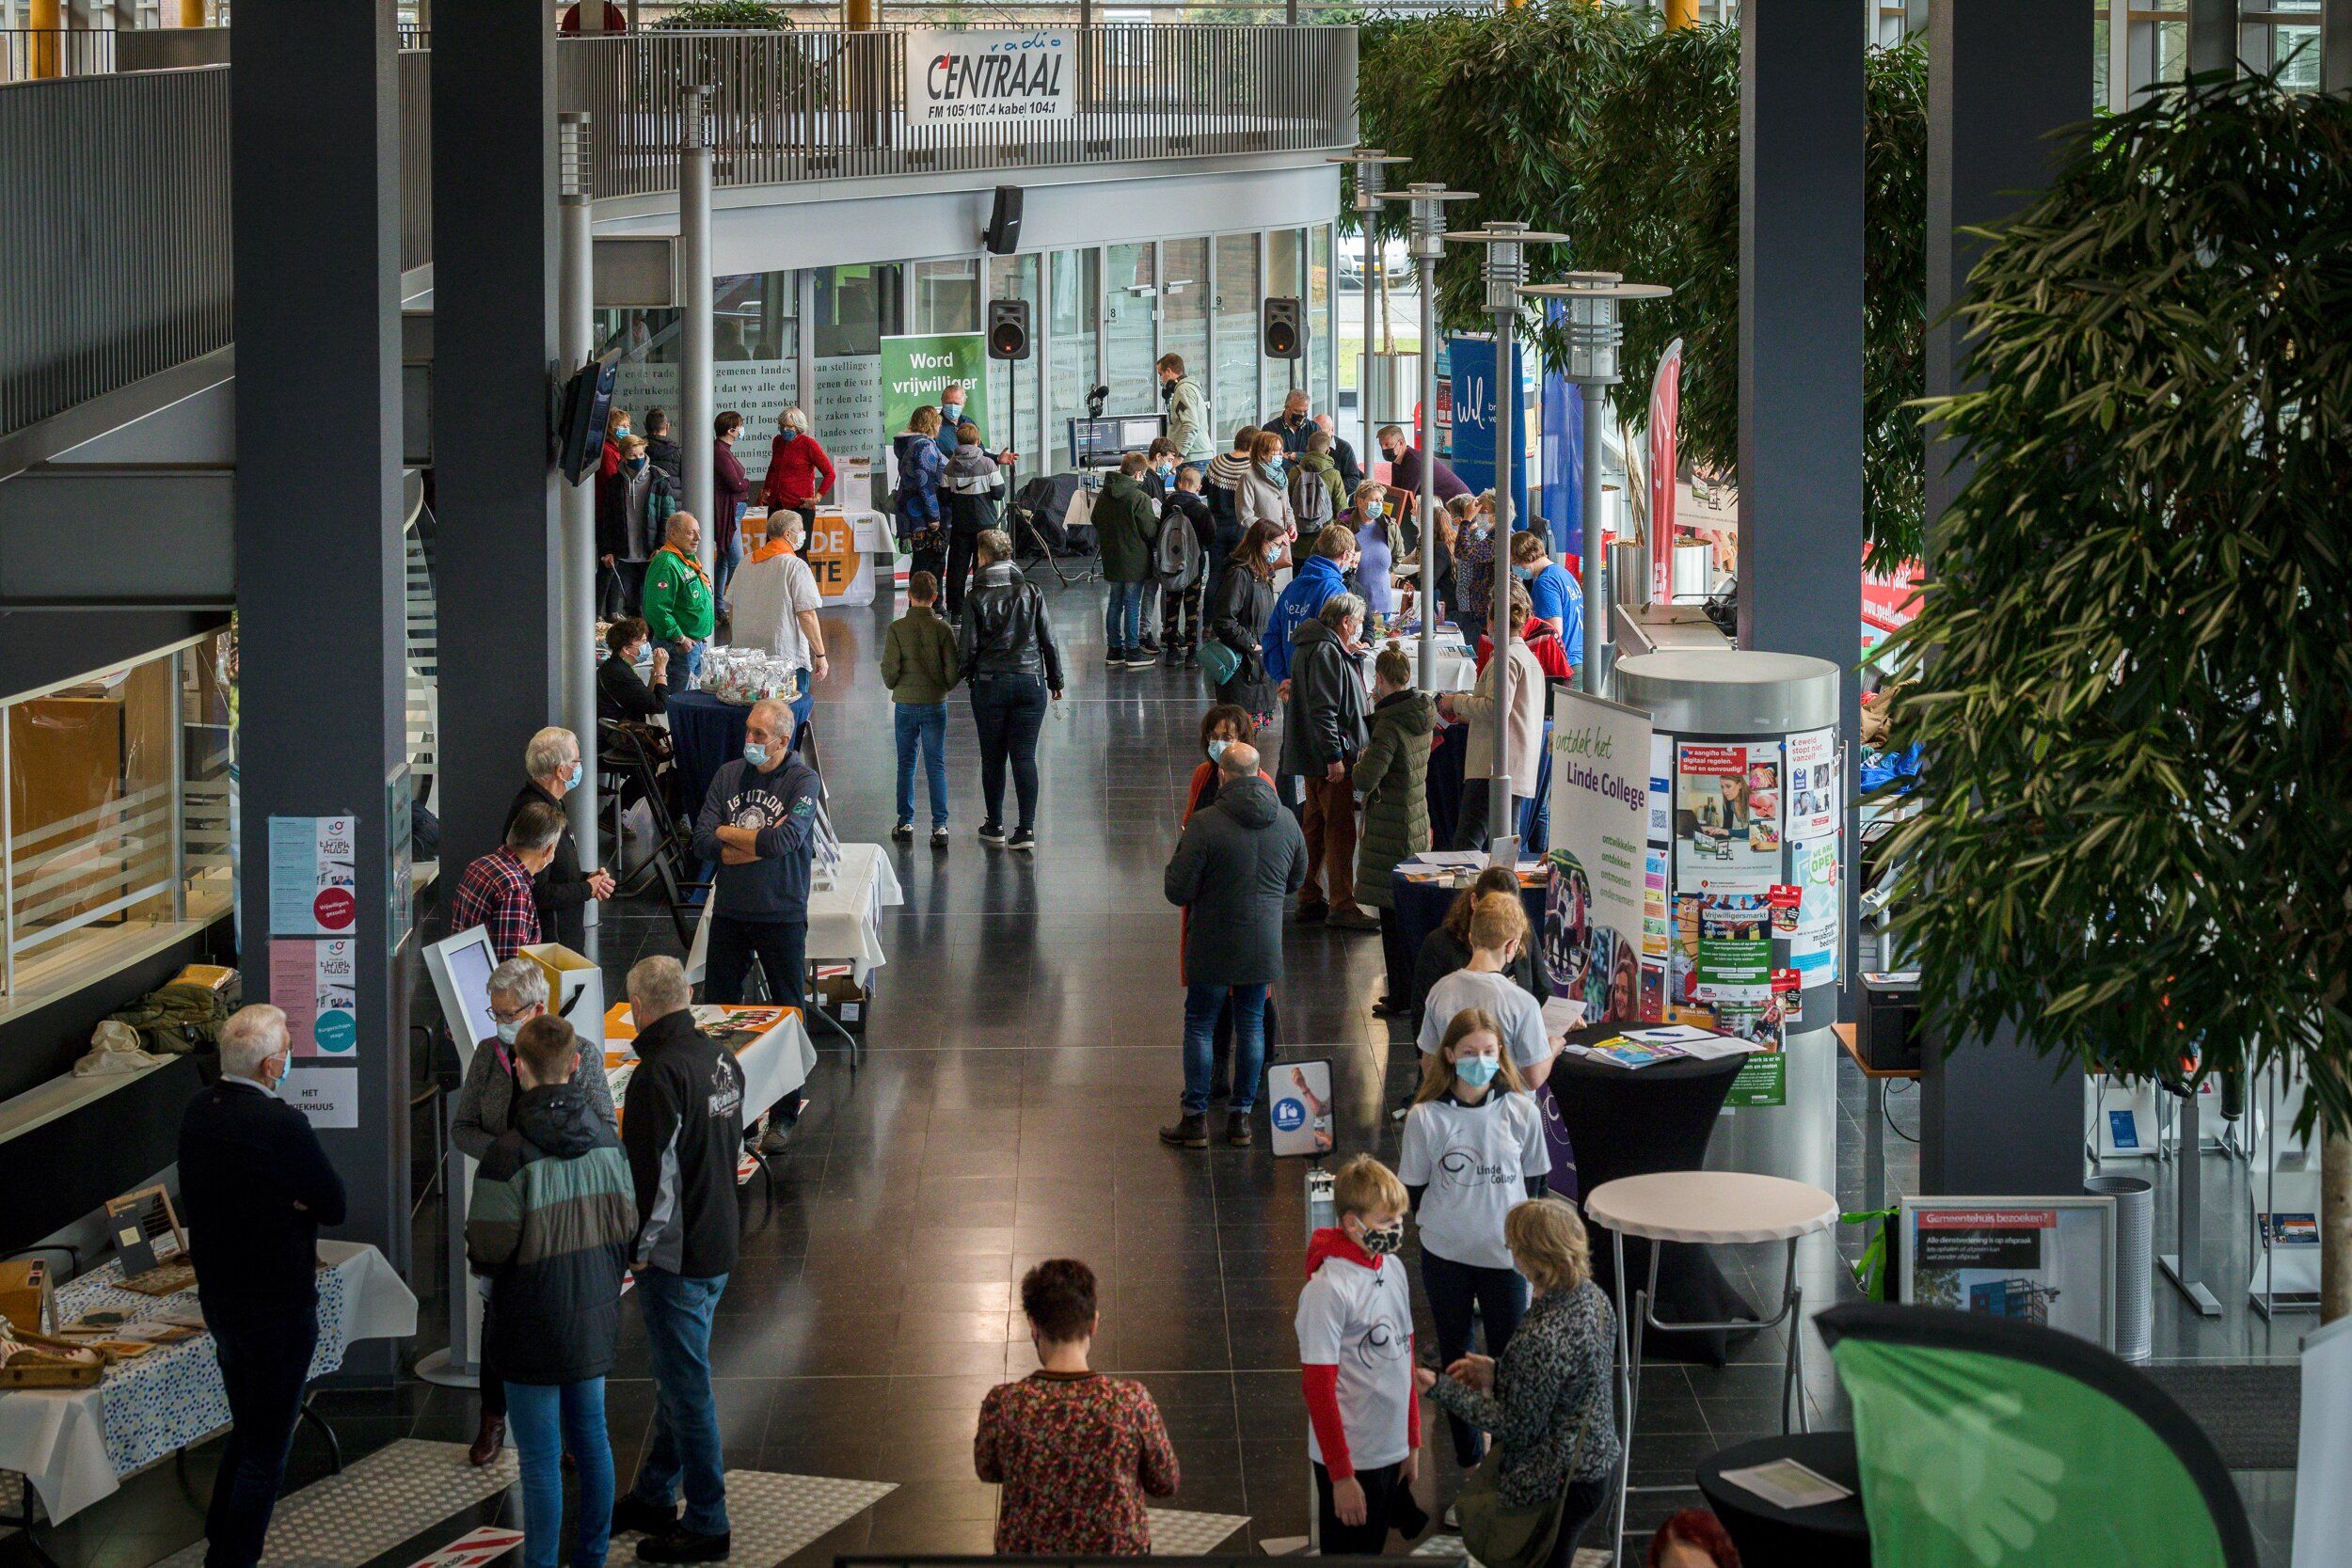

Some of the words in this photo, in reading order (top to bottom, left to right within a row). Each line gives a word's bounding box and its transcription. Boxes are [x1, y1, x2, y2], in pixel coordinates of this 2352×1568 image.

[991, 32, 1061, 53] radio
[928, 52, 1061, 100] CENTRAAL
[928, 105, 944, 119] FM
[946, 103, 995, 117] 105/107.4
[998, 102, 1026, 115] kabel
[1029, 102, 1056, 114] 104.1
[1216, 295, 1222, 306] 9
[1110, 308, 1117, 318] 8
[910, 352, 954, 369] Word
[716, 368, 756, 377] gemenen
[761, 366, 791, 375] landes
[722, 385, 737, 393] dat
[757, 383, 776, 392] alle
[779, 382, 796, 391] den
[818, 380, 841, 389] genen
[844, 378, 856, 387] die
[716, 401, 737, 409] wort
[741, 400, 757, 408] den
[837, 395, 851, 404] den
[825, 411, 850, 420] zaken
[820, 428, 847, 437] landes
[827, 444, 858, 452] burgers
[1555, 728, 1592, 758] ontdek
[1594, 726, 1613, 760] het
[1792, 737, 1818, 747] eweld
[1792, 746, 1810, 754] stopt
[1811, 744, 1822, 752] niet
[1792, 752, 1817, 763] vanzelf
[1708, 765, 1743, 773] eenvoudig!
[1566, 761, 1598, 792] Linde
[1601, 772, 1645, 811] College
[1602, 835, 1637, 853] ontwikkelen
[1601, 853, 1631, 870] ontdekken
[1811, 852, 1835, 873] OPEN
[1600, 871, 1631, 888] ontmoeten
[326, 909, 346, 918] gezocht
[1704, 911, 1767, 920] Vrijwilligersmarkt
[1476, 1164, 1502, 1175] Linde
[1926, 1213, 1995, 1224] Gemeentehuis
[1996, 1212, 2048, 1223] bezoeken?
[2004, 1236, 2032, 1244] afspraak
